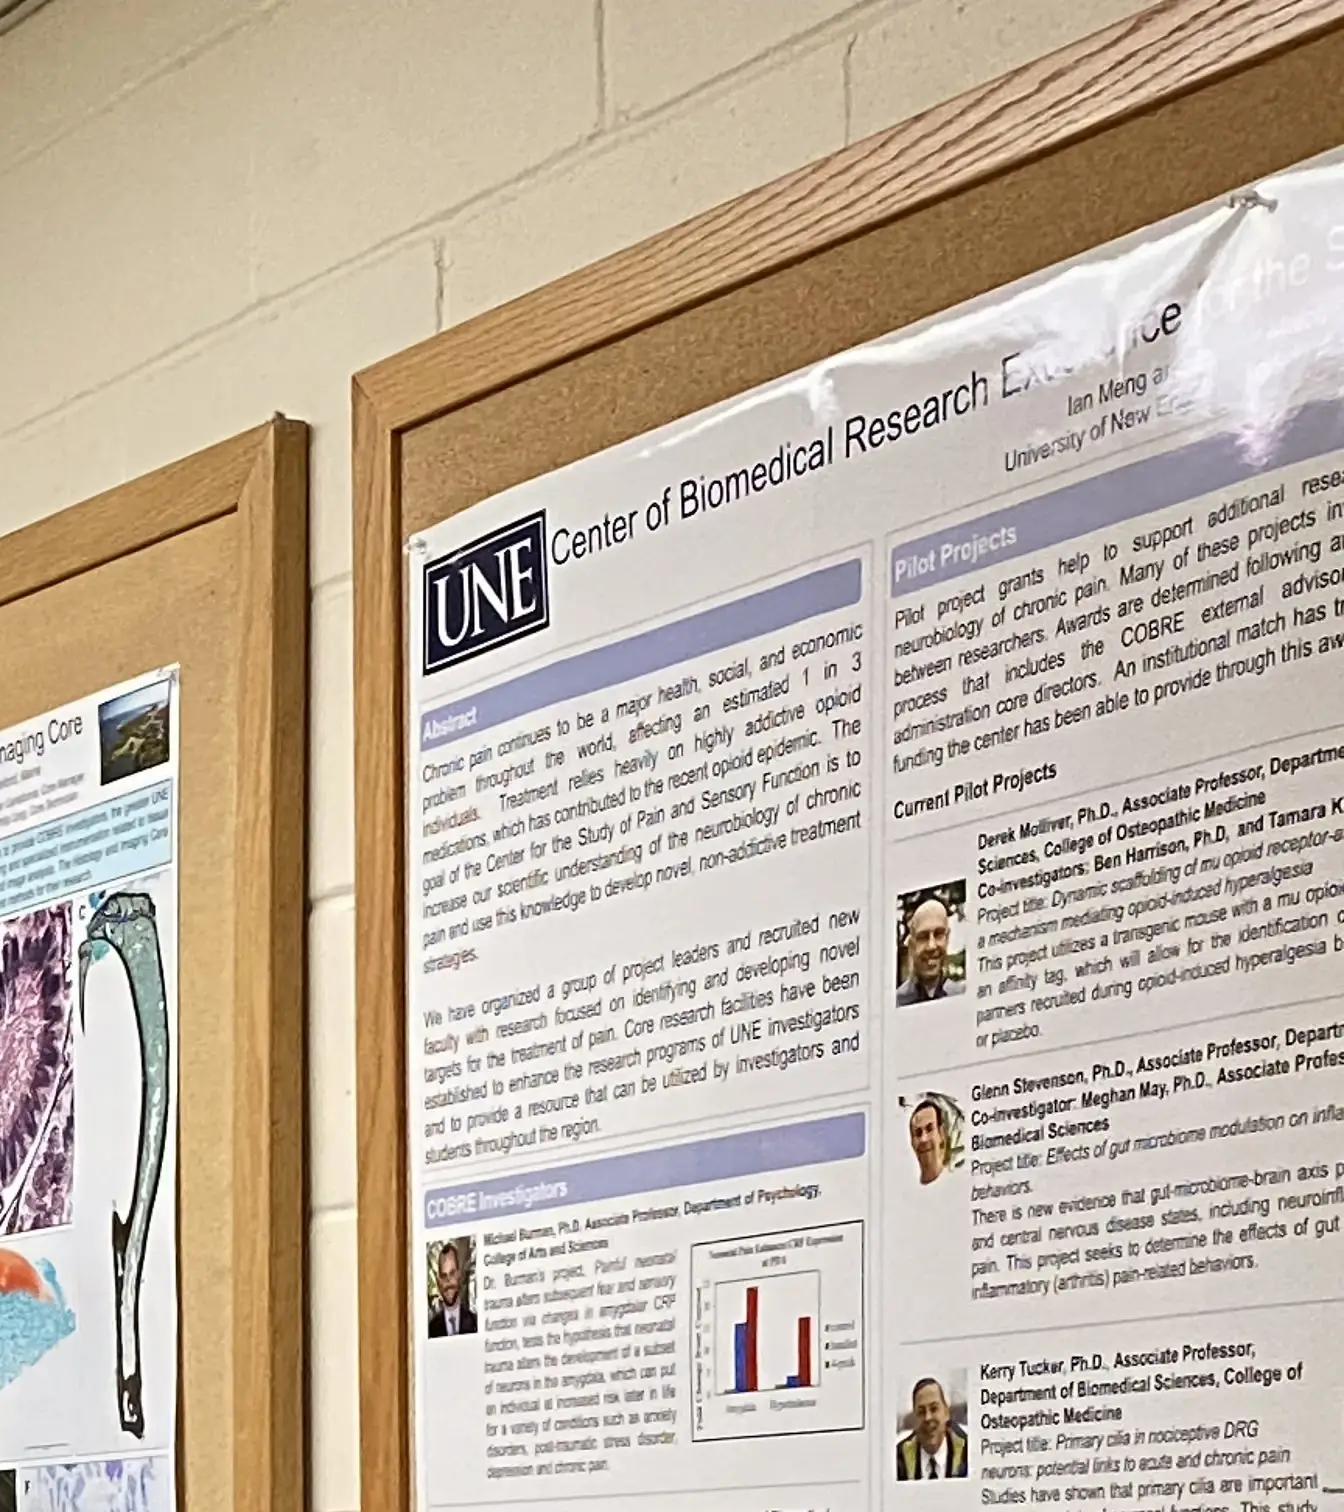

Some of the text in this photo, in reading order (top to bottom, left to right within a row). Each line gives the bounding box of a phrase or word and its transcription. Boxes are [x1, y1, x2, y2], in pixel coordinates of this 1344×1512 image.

[1067, 392, 1094, 415] Ian
[1098, 372, 1148, 404] Meng
[550, 370, 990, 566] Center of Biomedical Research
[1004, 430, 1085, 472] University
[1088, 416, 1107, 441] of
[1110, 405, 1151, 434] New
[894, 526, 1017, 579] Pilot Projects
[894, 484, 1285, 630] Pilot project grants help to support additional
[894, 618, 984, 657] neurobiology
[990, 604, 1006, 628] of
[1012, 589, 1067, 621] chronic
[1119, 559, 1165, 586] Many
[1172, 545, 1190, 570] of
[1196, 534, 1240, 562] these
[1247, 510, 1316, 548] projects
[433, 537, 537, 647] UNE
[893, 656, 952, 687] between
[1055, 605, 1111, 636] Awards
[1116, 596, 1144, 618] are
[1150, 561, 1240, 607] determined
[1245, 540, 1322, 576] following
[893, 587, 1264, 720] process that includes the COBRE external
[893, 604, 1327, 745] administration core directors. An institutional match has
[47, 715, 83, 745] Core
[421, 756, 465, 782] Chronic
[468, 746, 493, 770] pain
[496, 725, 552, 757] continues
[556, 719, 570, 737] to
[576, 712, 594, 731] be
[600, 707, 610, 723] a
[615, 693, 652, 717] major
[759, 645, 785, 670] and
[791, 623, 863, 659] economic
[892, 639, 1313, 773] funding the center has been able to provide through this
[893, 763, 1057, 819] Current Pilot Projects
[977, 826, 1016, 851] Derek
[1121, 784, 1192, 814] Associate
[1194, 764, 1266, 795] Professor,
[1043, 834, 1094, 858] College
[1097, 825, 1113, 846] of
[1115, 807, 1201, 841] Osteopathic
[1203, 791, 1266, 819] Medicine
[1093, 853, 1122, 872] Ben
[1125, 839, 1191, 865] Harrison,
[1237, 814, 1264, 837] and
[1269, 804, 1327, 829] Tamara
[971, 1083, 1010, 1102] Glenn
[1012, 1070, 1088, 1095] Stevenson,
[1136, 1048, 1203, 1073] Associate
[1206, 1035, 1280, 1060] Professor,
[1080, 1087, 1136, 1109] Meghan
[1216, 1059, 1290, 1084] Associate
[971, 1117, 1110, 1152] Biomedical Sciences
[979, 1363, 1016, 1382] Kerry
[1113, 1348, 1179, 1368] Associate
[1182, 1342, 1256, 1361] Professor,
[980, 1360, 1303, 1407] Department of Biomedical Sciences, College of
[980, 1405, 1123, 1431] Osteopathic Medicine
